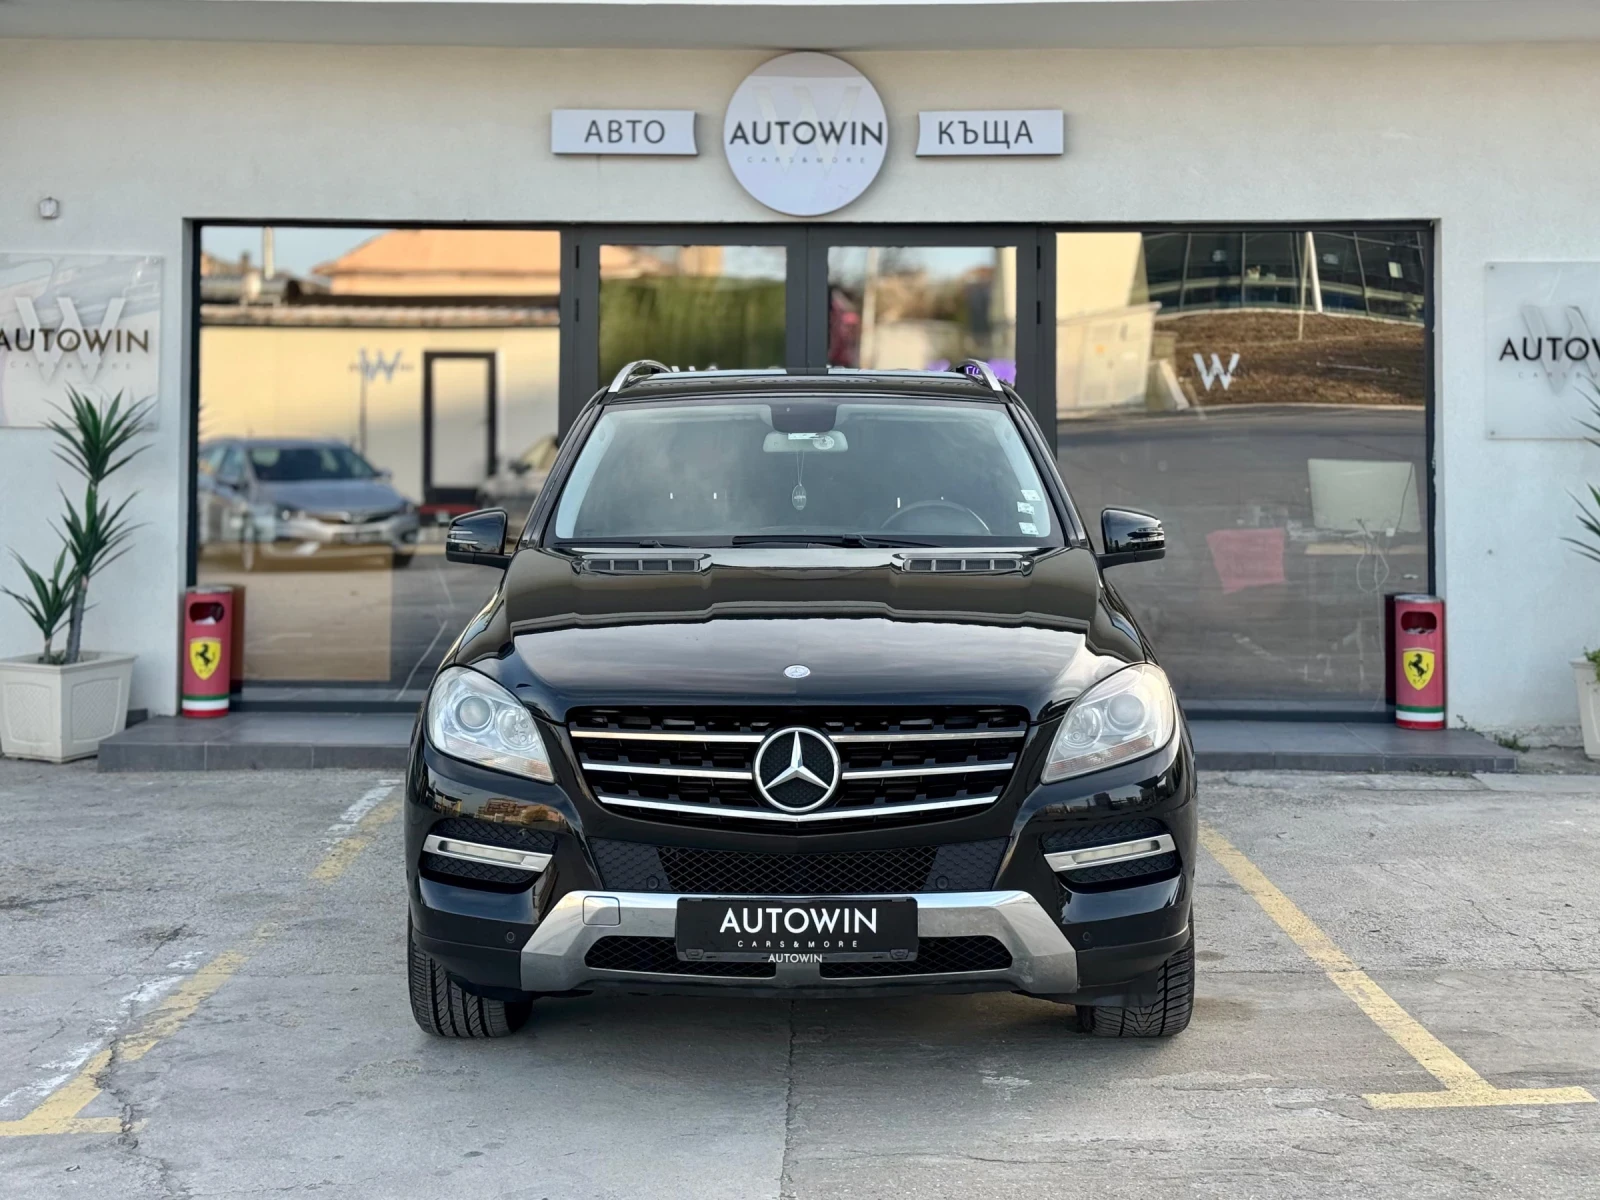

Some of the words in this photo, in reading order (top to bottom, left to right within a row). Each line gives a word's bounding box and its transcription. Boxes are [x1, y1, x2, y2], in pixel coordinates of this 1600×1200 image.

[584, 119, 666, 144] АВТО
[729, 121, 883, 146] AUTOWIN
[938, 119, 1033, 150] КЪЩА
[1192, 353, 1240, 392] W
[719, 907, 877, 934] AUTOWIN
